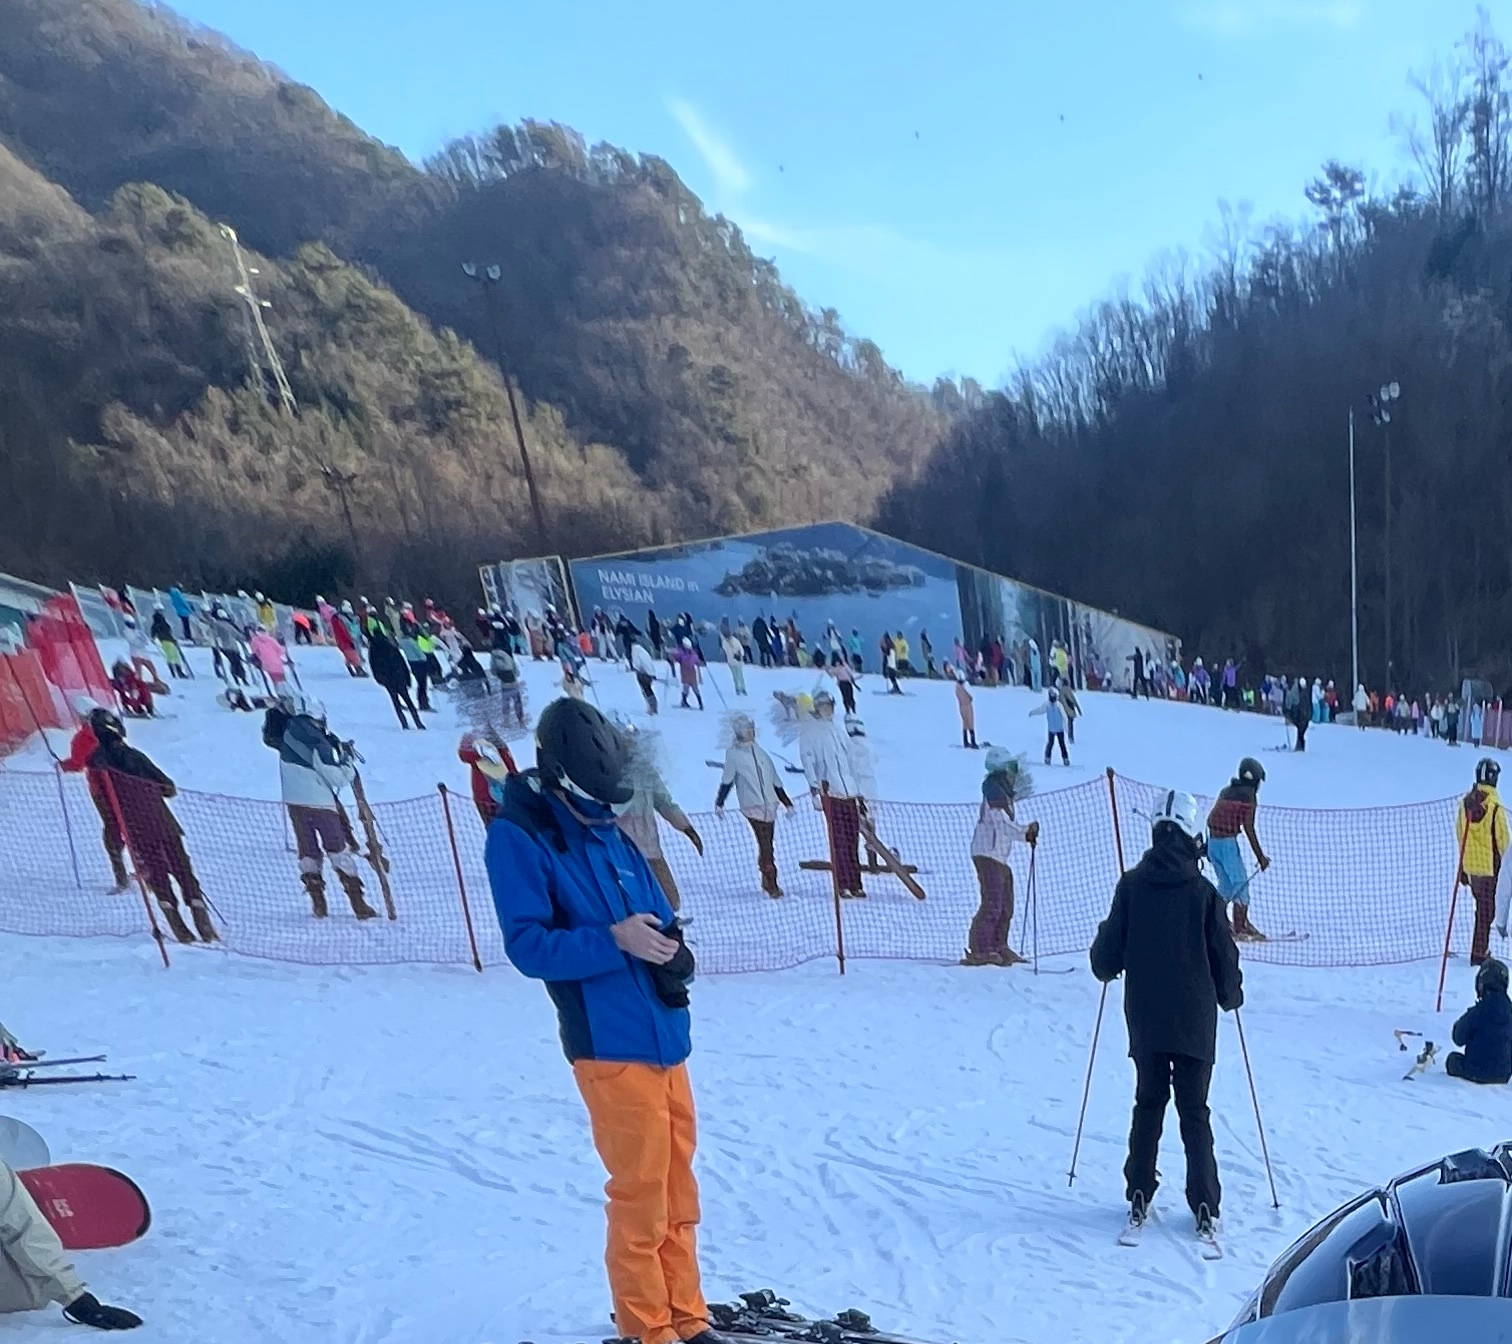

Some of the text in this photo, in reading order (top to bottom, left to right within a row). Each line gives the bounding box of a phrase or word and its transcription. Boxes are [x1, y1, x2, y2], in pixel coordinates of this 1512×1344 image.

[598, 568, 636, 586] NAMI
[638, 572, 685, 592] ISLAND
[601, 584, 655, 604] ELYSIAN
